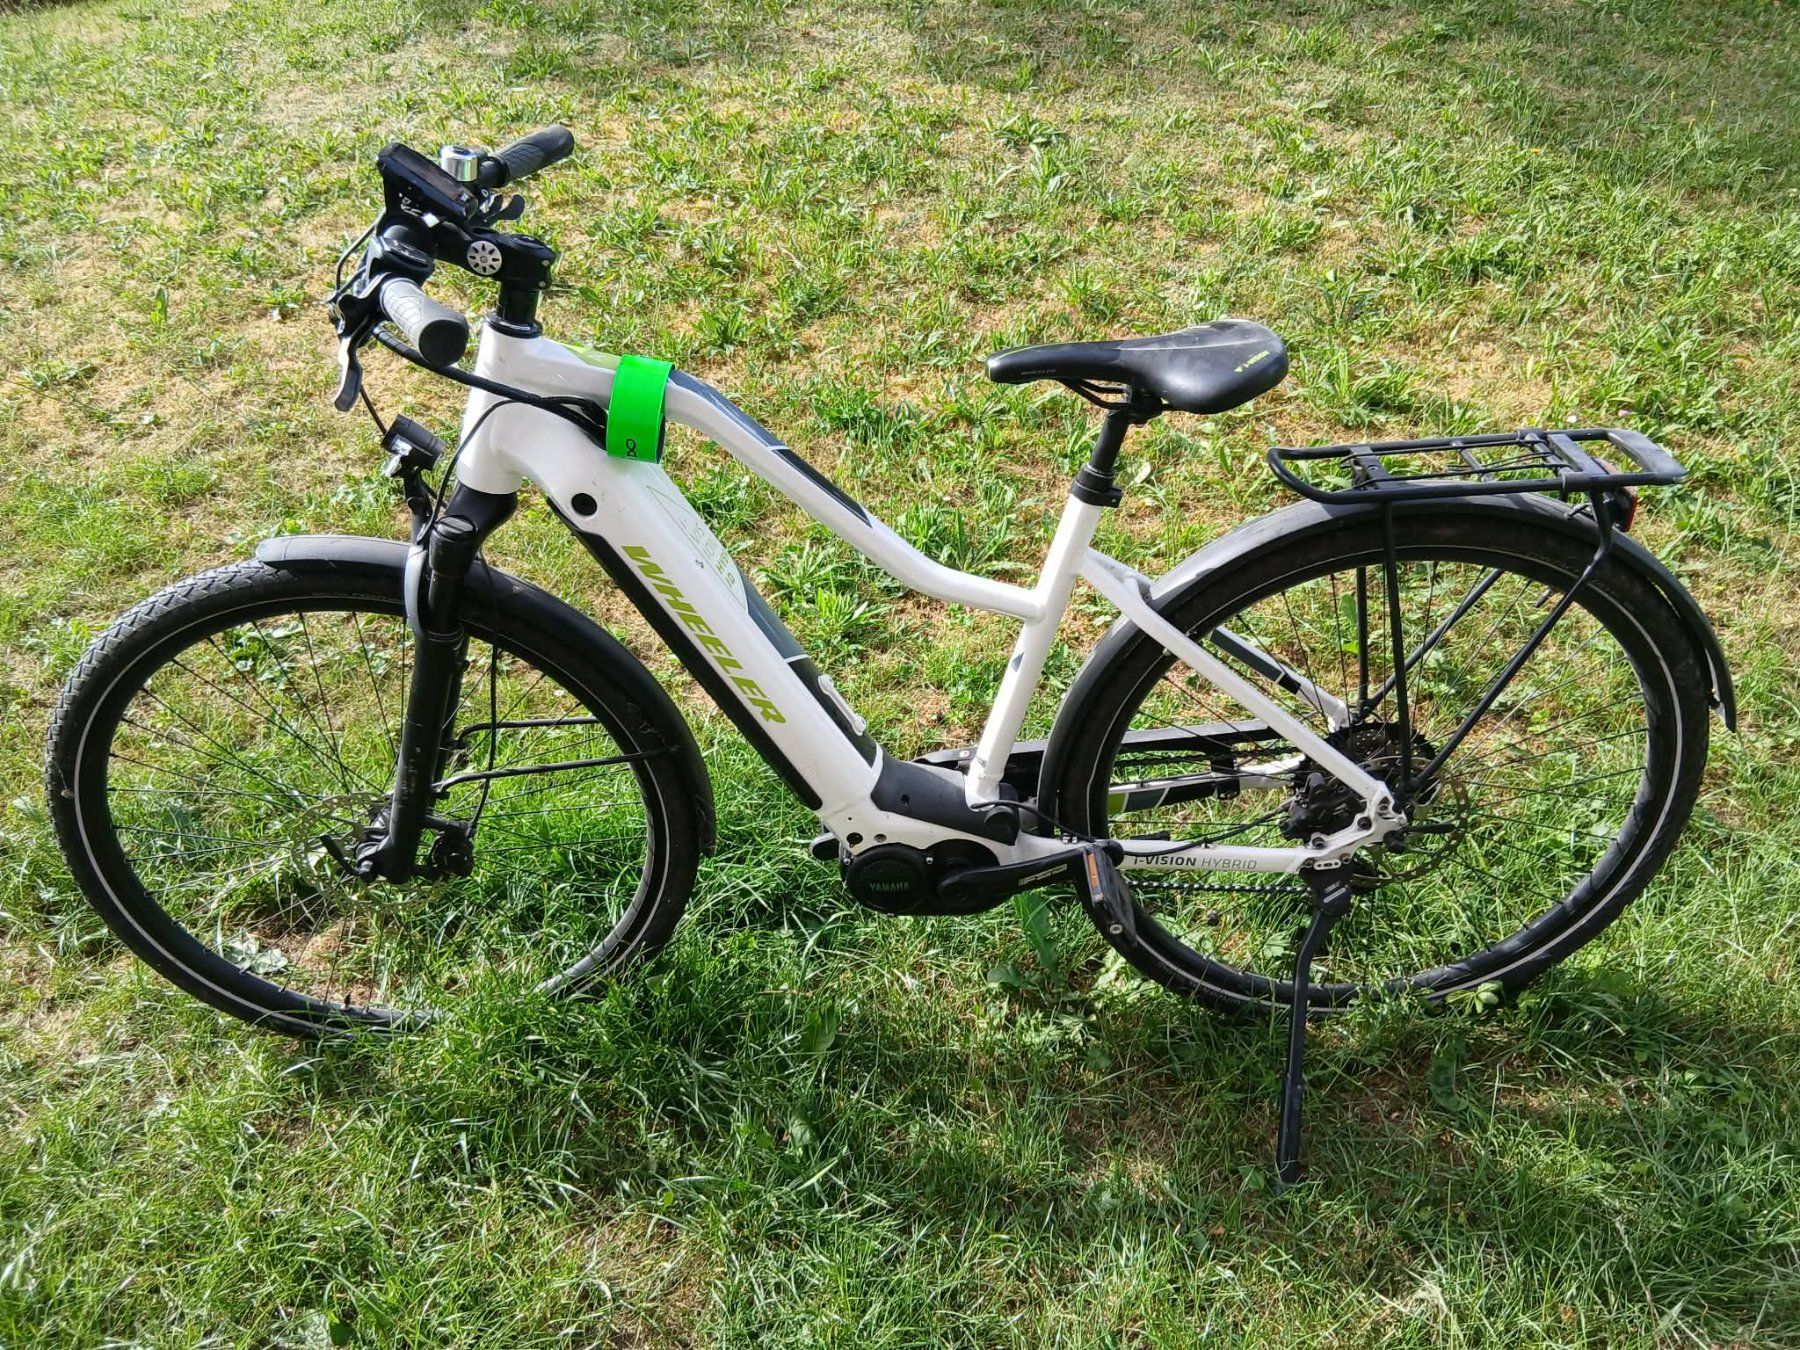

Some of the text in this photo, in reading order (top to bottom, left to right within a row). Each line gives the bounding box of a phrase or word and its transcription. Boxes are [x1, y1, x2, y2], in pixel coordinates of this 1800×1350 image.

[621, 546, 786, 724] WHEELER
[1201, 858, 1257, 870] HYBRID
[869, 882, 910, 892] YAMAHA
